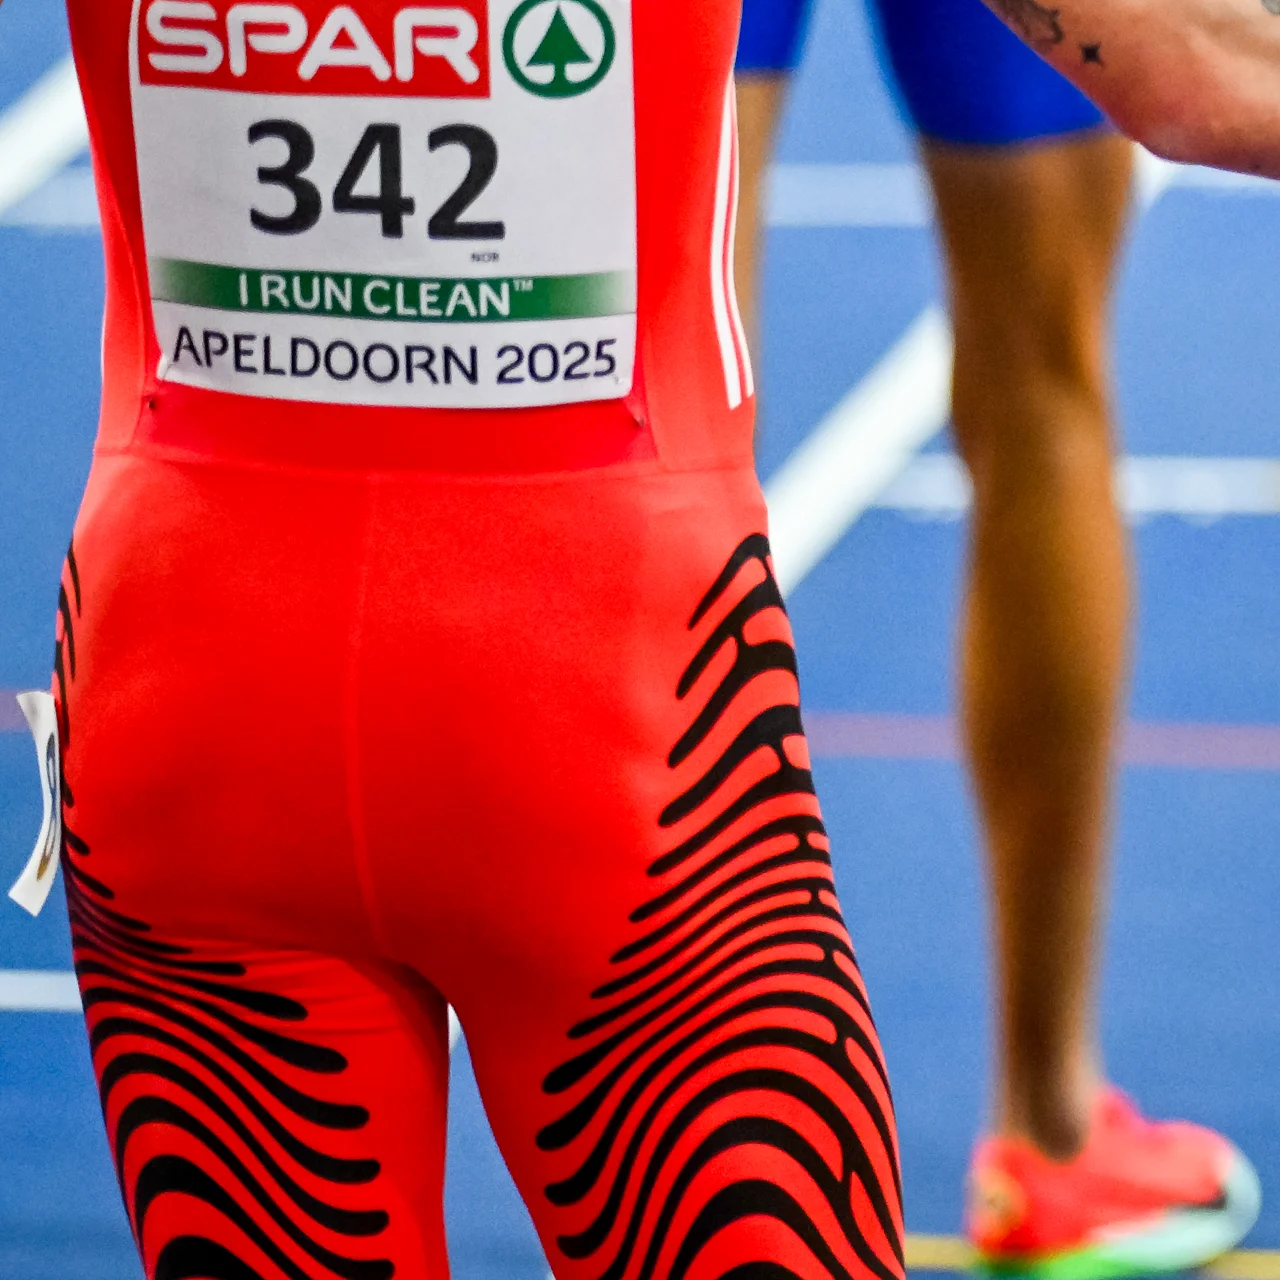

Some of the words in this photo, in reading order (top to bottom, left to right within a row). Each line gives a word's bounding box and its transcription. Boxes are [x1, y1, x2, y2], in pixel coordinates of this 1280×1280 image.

[145, 0, 480, 84] SPAR
[247, 118, 506, 241] 342
[239, 274, 249, 303] I
[260, 274, 353, 313] RUN
[172, 326, 479, 385] APELDOORN
[496, 338, 618, 385] 2025
